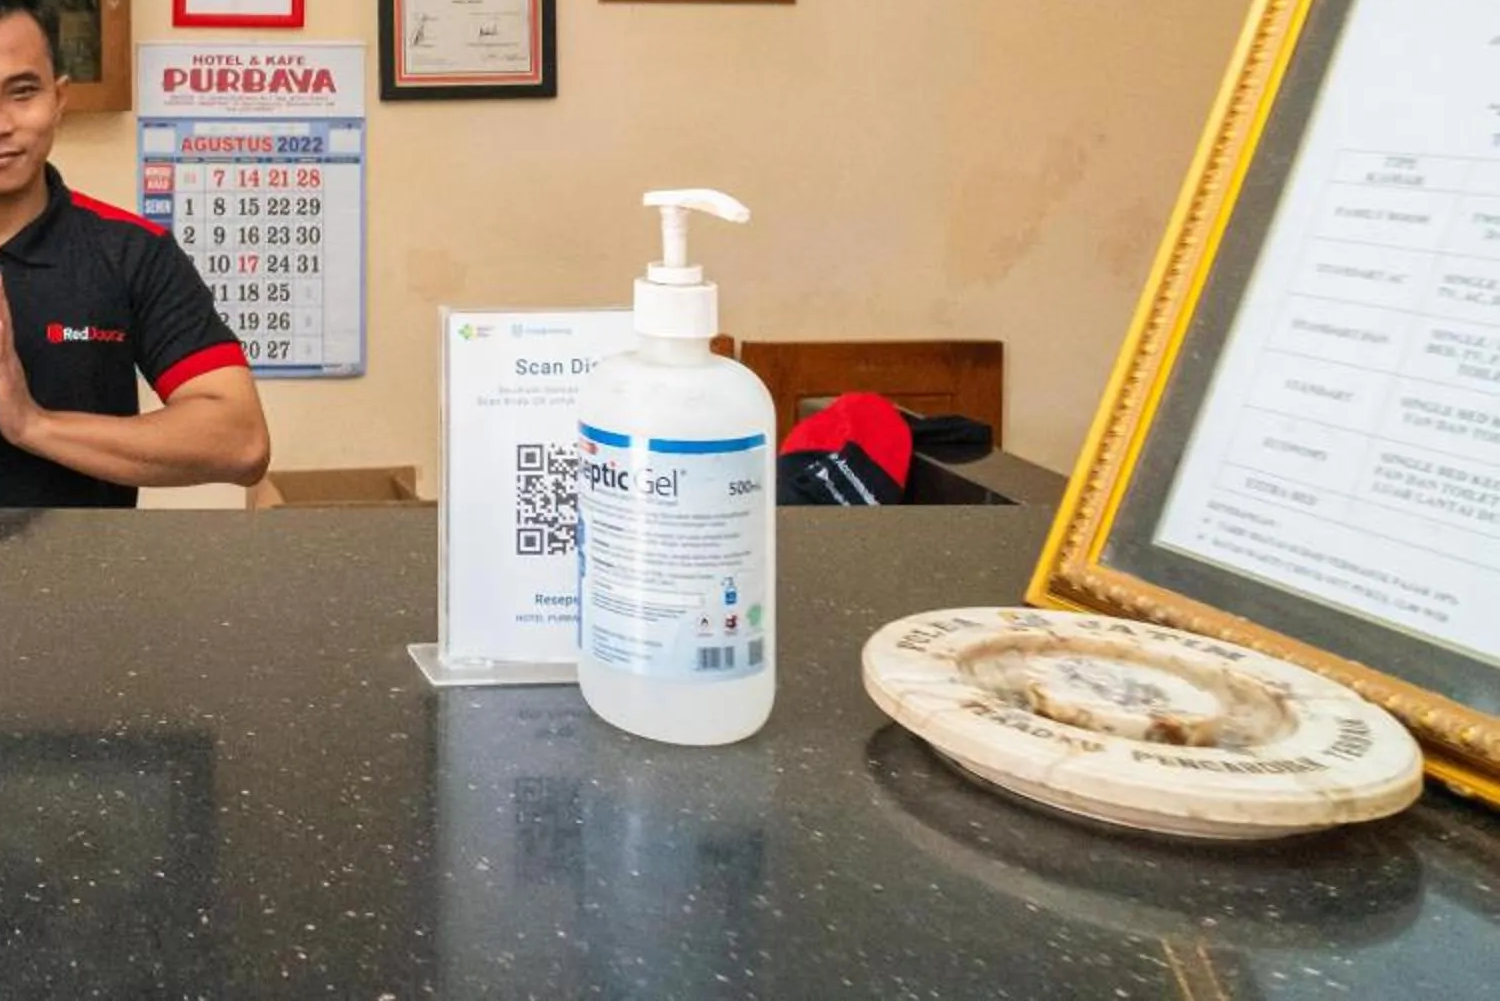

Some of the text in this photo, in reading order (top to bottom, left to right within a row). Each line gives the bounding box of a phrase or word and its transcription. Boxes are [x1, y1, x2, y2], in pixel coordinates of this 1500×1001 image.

[193, 55, 307, 65] HOTEL & KAFE
[163, 68, 337, 93] PURBAYA
[182, 136, 323, 152] AGUSTUS 2022
[213, 170, 226, 187] 7
[238, 169, 260, 187] 14
[268, 169, 289, 187] 21
[297, 169, 321, 187] 28
[186, 198, 194, 216] 1
[213, 198, 226, 216] 8
[238, 198, 260, 216] 15
[267, 198, 291, 216] 22
[296, 198, 322, 216] 29
[184, 226, 321, 244] 2 9 16 23 30
[209, 255, 320, 273] 10 17 24 31
[238, 283, 260, 301] 18
[267, 283, 291, 301] 25
[238, 312, 260, 330] 19
[267, 312, 291, 330] 26
[267, 341, 291, 359] 27
[515, 358, 564, 375] Scan
